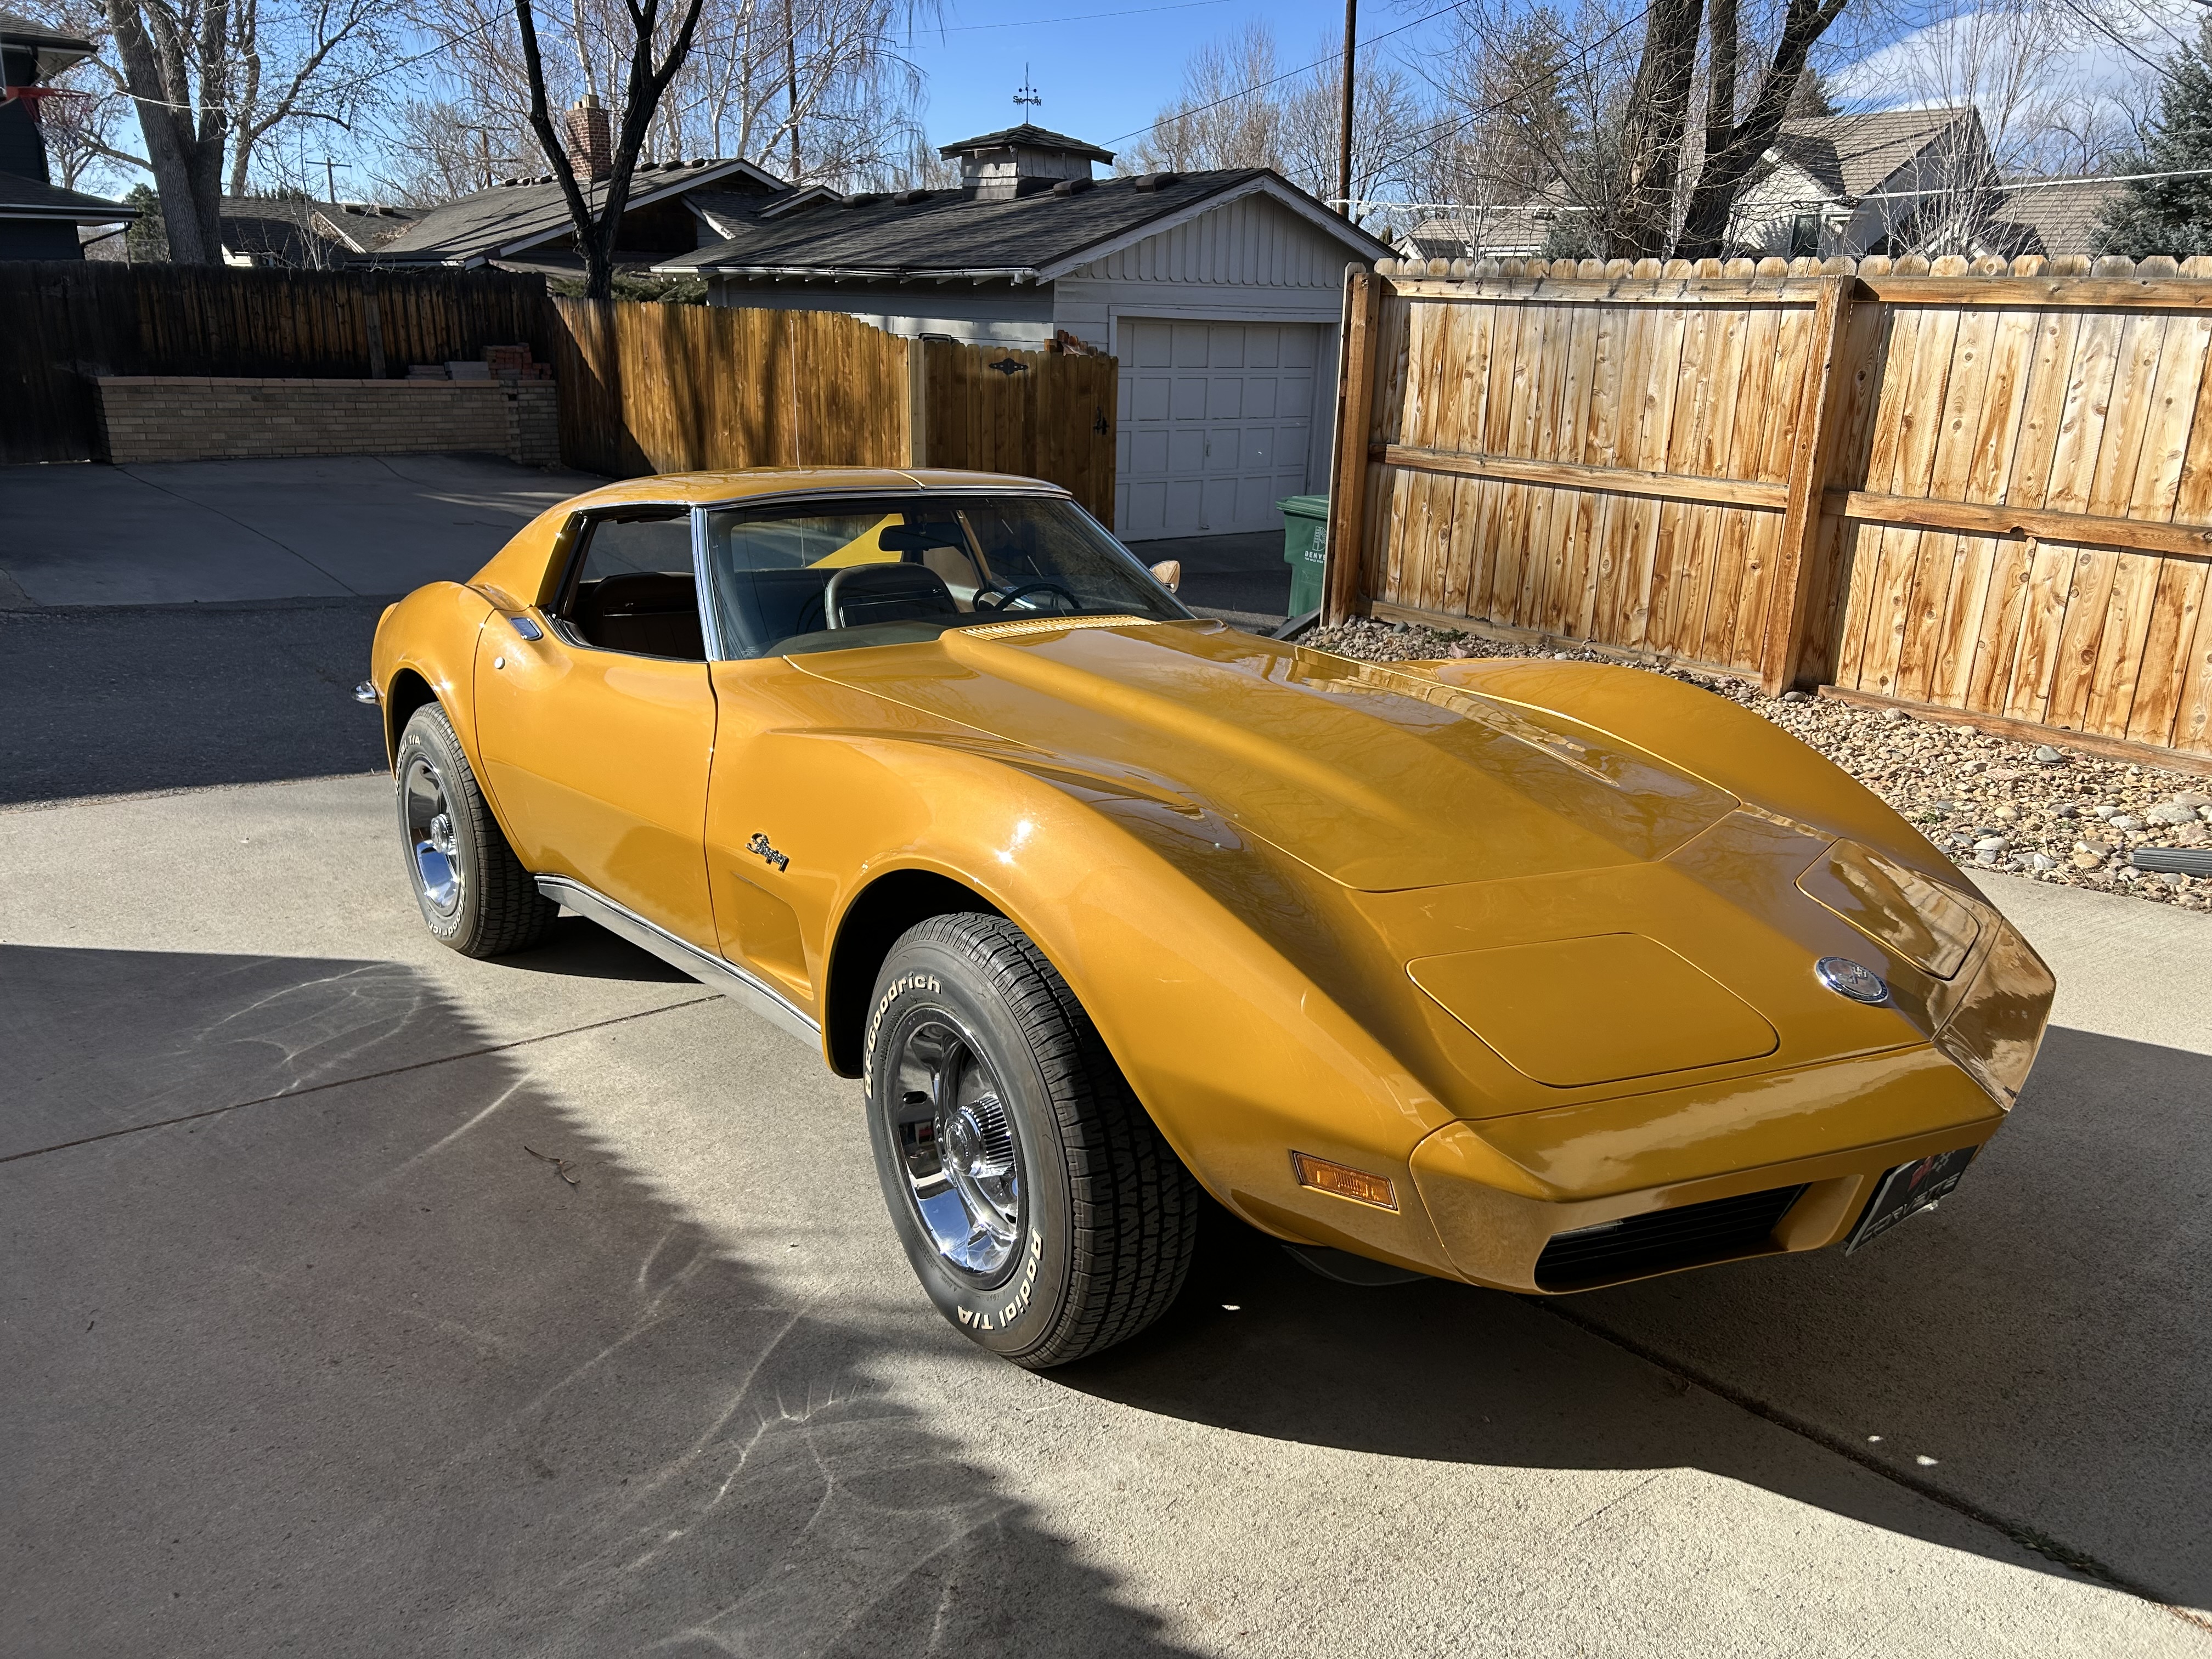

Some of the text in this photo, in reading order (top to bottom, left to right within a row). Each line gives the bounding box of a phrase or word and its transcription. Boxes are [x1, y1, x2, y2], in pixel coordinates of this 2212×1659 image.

[1305, 551, 1325, 560] DENVE
[408, 734, 421, 746] T/A
[865, 972, 941, 1099] BFGoodrich
[957, 1227, 1043, 1330] Radial T/A
